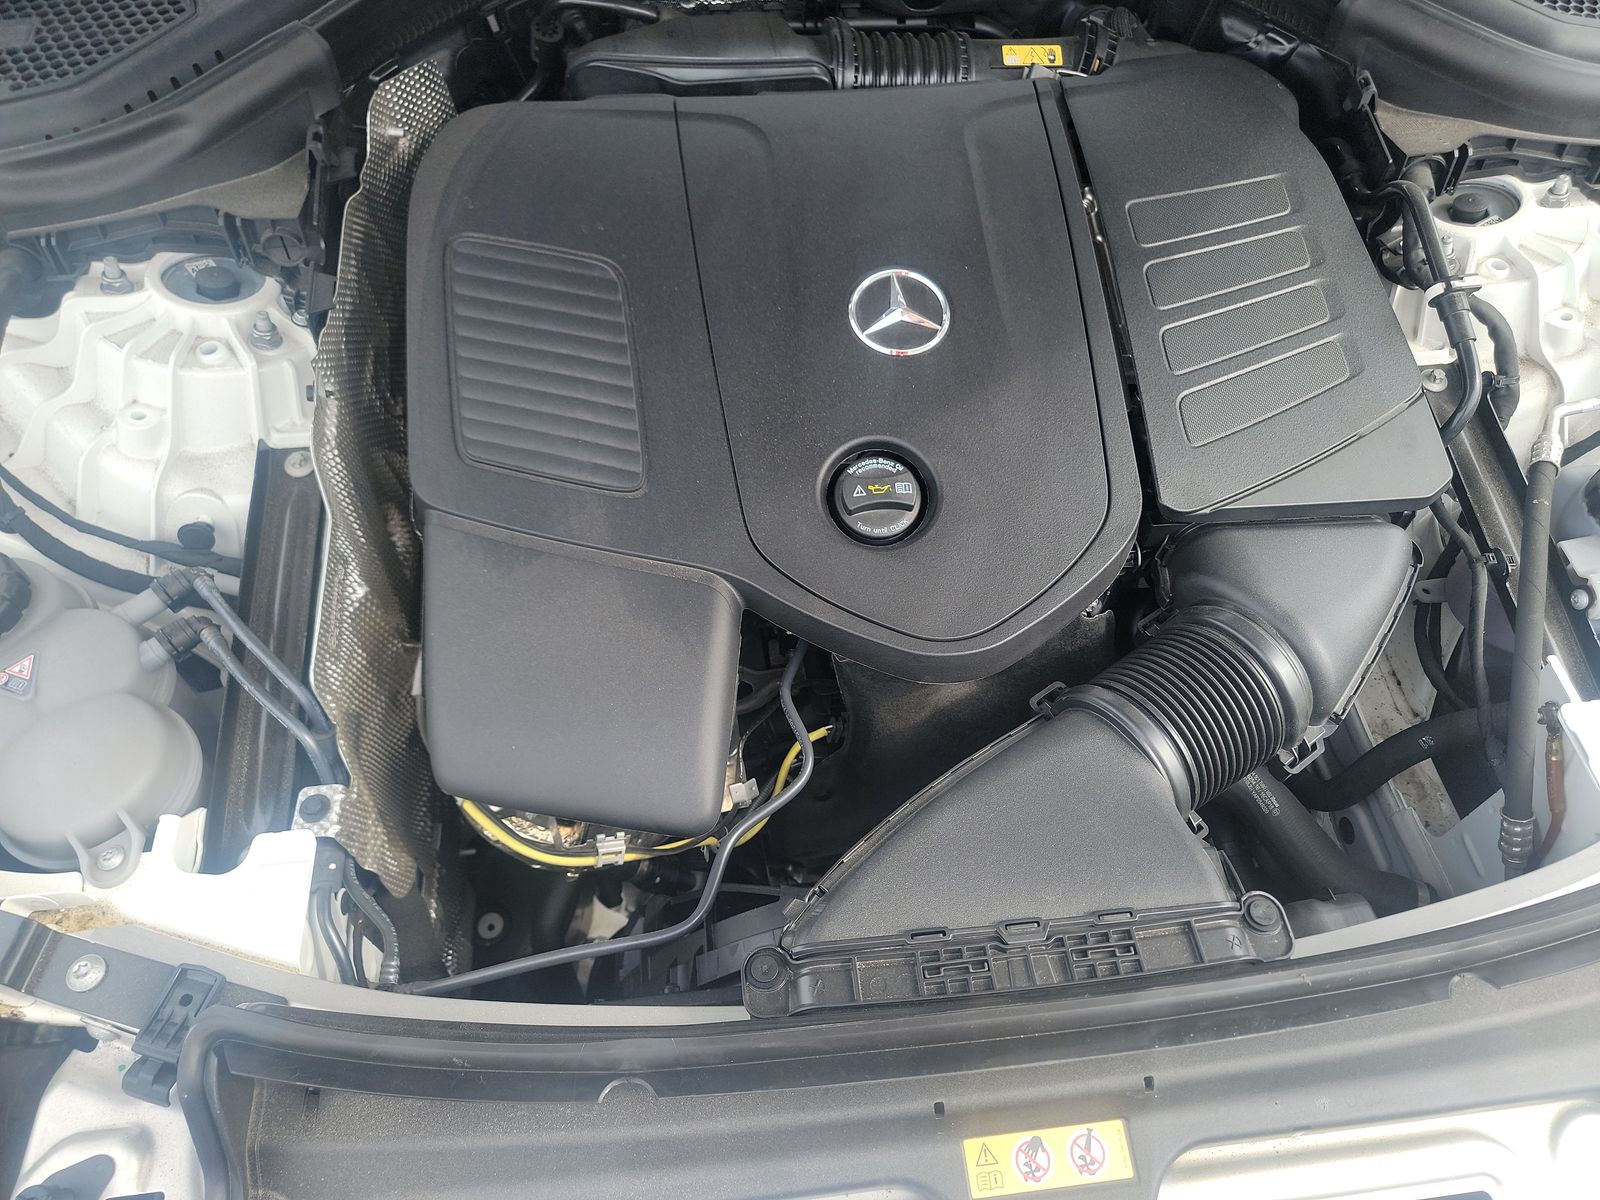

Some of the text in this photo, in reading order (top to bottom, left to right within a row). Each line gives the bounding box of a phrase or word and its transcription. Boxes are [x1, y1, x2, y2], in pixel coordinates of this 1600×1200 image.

[847, 458, 895, 474] Mercedes-Benz
[856, 464, 897, 475] recommended
[857, 519, 909, 534] Turn until CLICK
